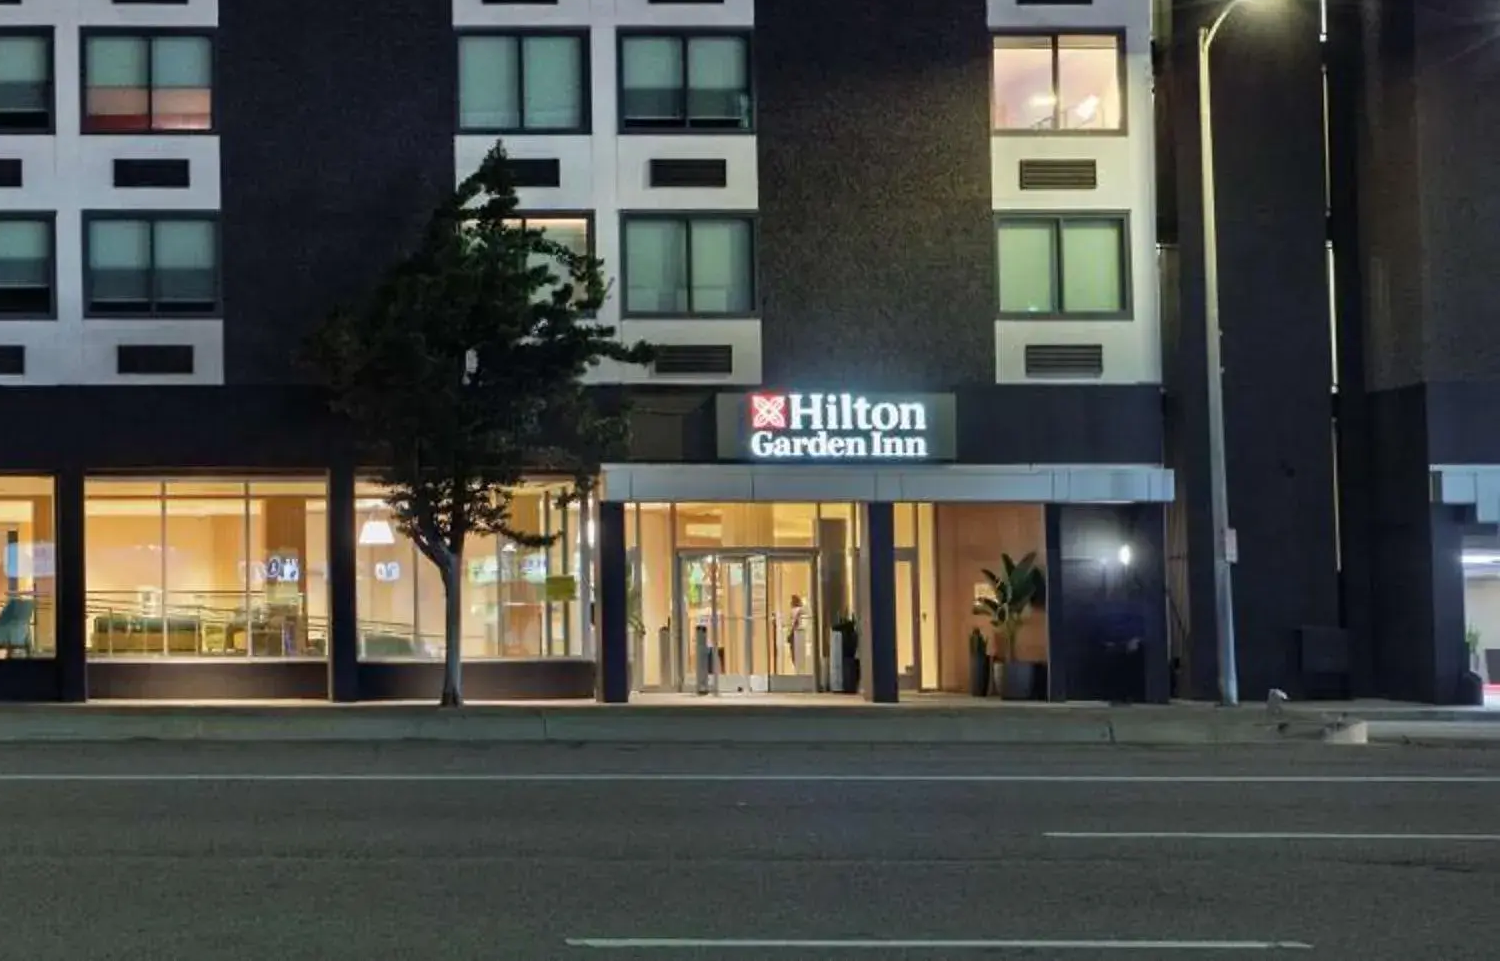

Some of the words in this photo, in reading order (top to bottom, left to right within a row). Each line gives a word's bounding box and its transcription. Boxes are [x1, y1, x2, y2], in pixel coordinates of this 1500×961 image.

[788, 392, 927, 431] Hilton
[750, 430, 868, 457] Garden
[869, 430, 928, 457] Inn
